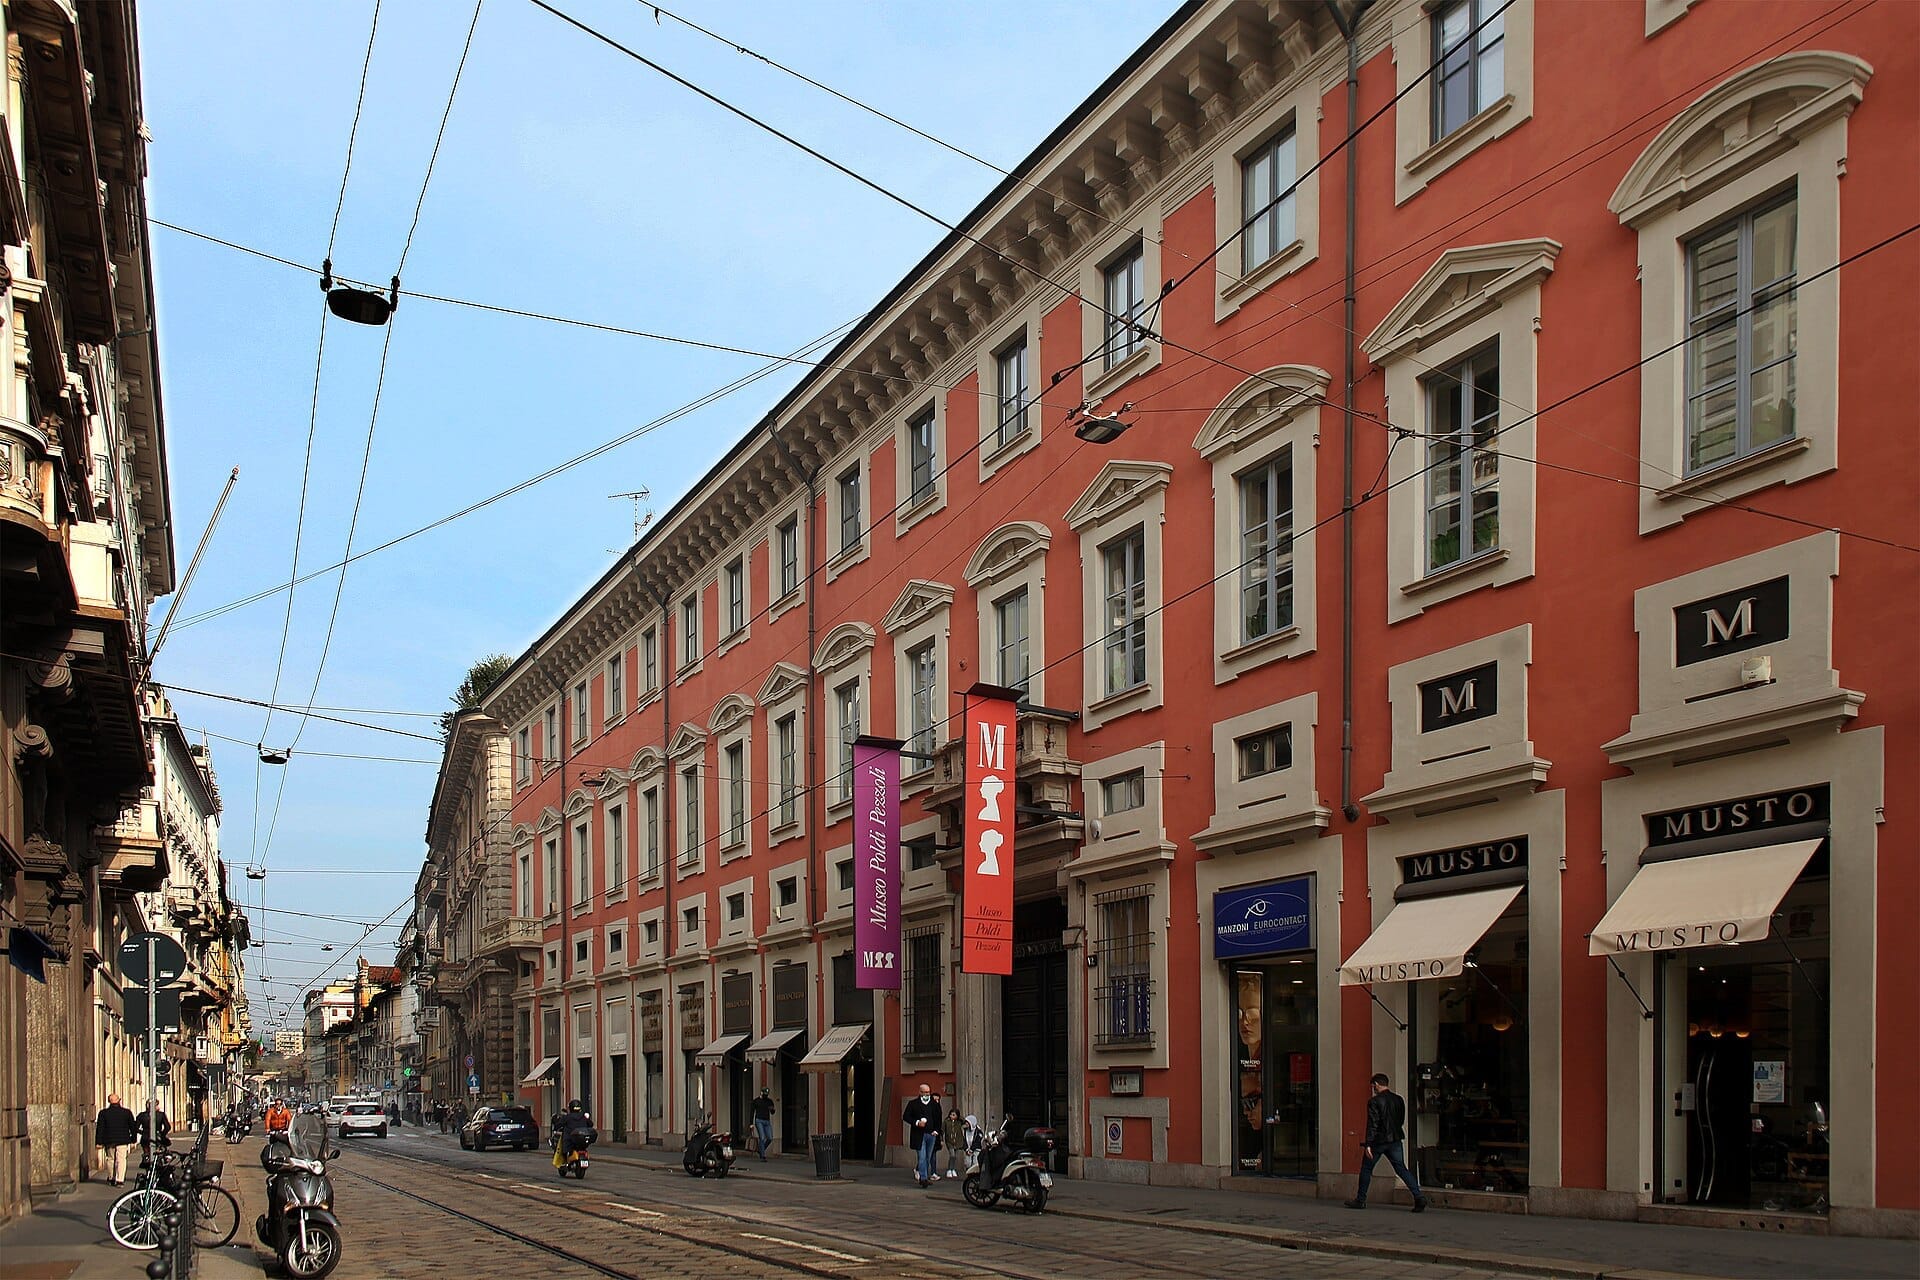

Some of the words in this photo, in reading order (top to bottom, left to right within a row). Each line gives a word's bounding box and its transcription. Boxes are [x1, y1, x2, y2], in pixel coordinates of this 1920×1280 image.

[1701, 596, 1757, 648] M
[1437, 678, 1478, 719] M
[977, 721, 1007, 771] M
[868, 765, 887, 827] Pezzoli
[1663, 792, 1814, 839] MUSTO
[869, 832, 887, 874] Poldi
[1413, 842, 1518, 878] MUSTO
[870, 878, 887, 931] Museo
[976, 904, 1003, 918] Museo
[975, 921, 1001, 937] Poldi
[1217, 922, 1249, 935] MANZONI
[1253, 914, 1307, 931] EUROCONTACT
[1615, 922, 1740, 952] MUSTO
[863, 951, 875, 969] M
[975, 940, 1001, 953] Pezzoli
[1358, 959, 1444, 983] MUSTO
